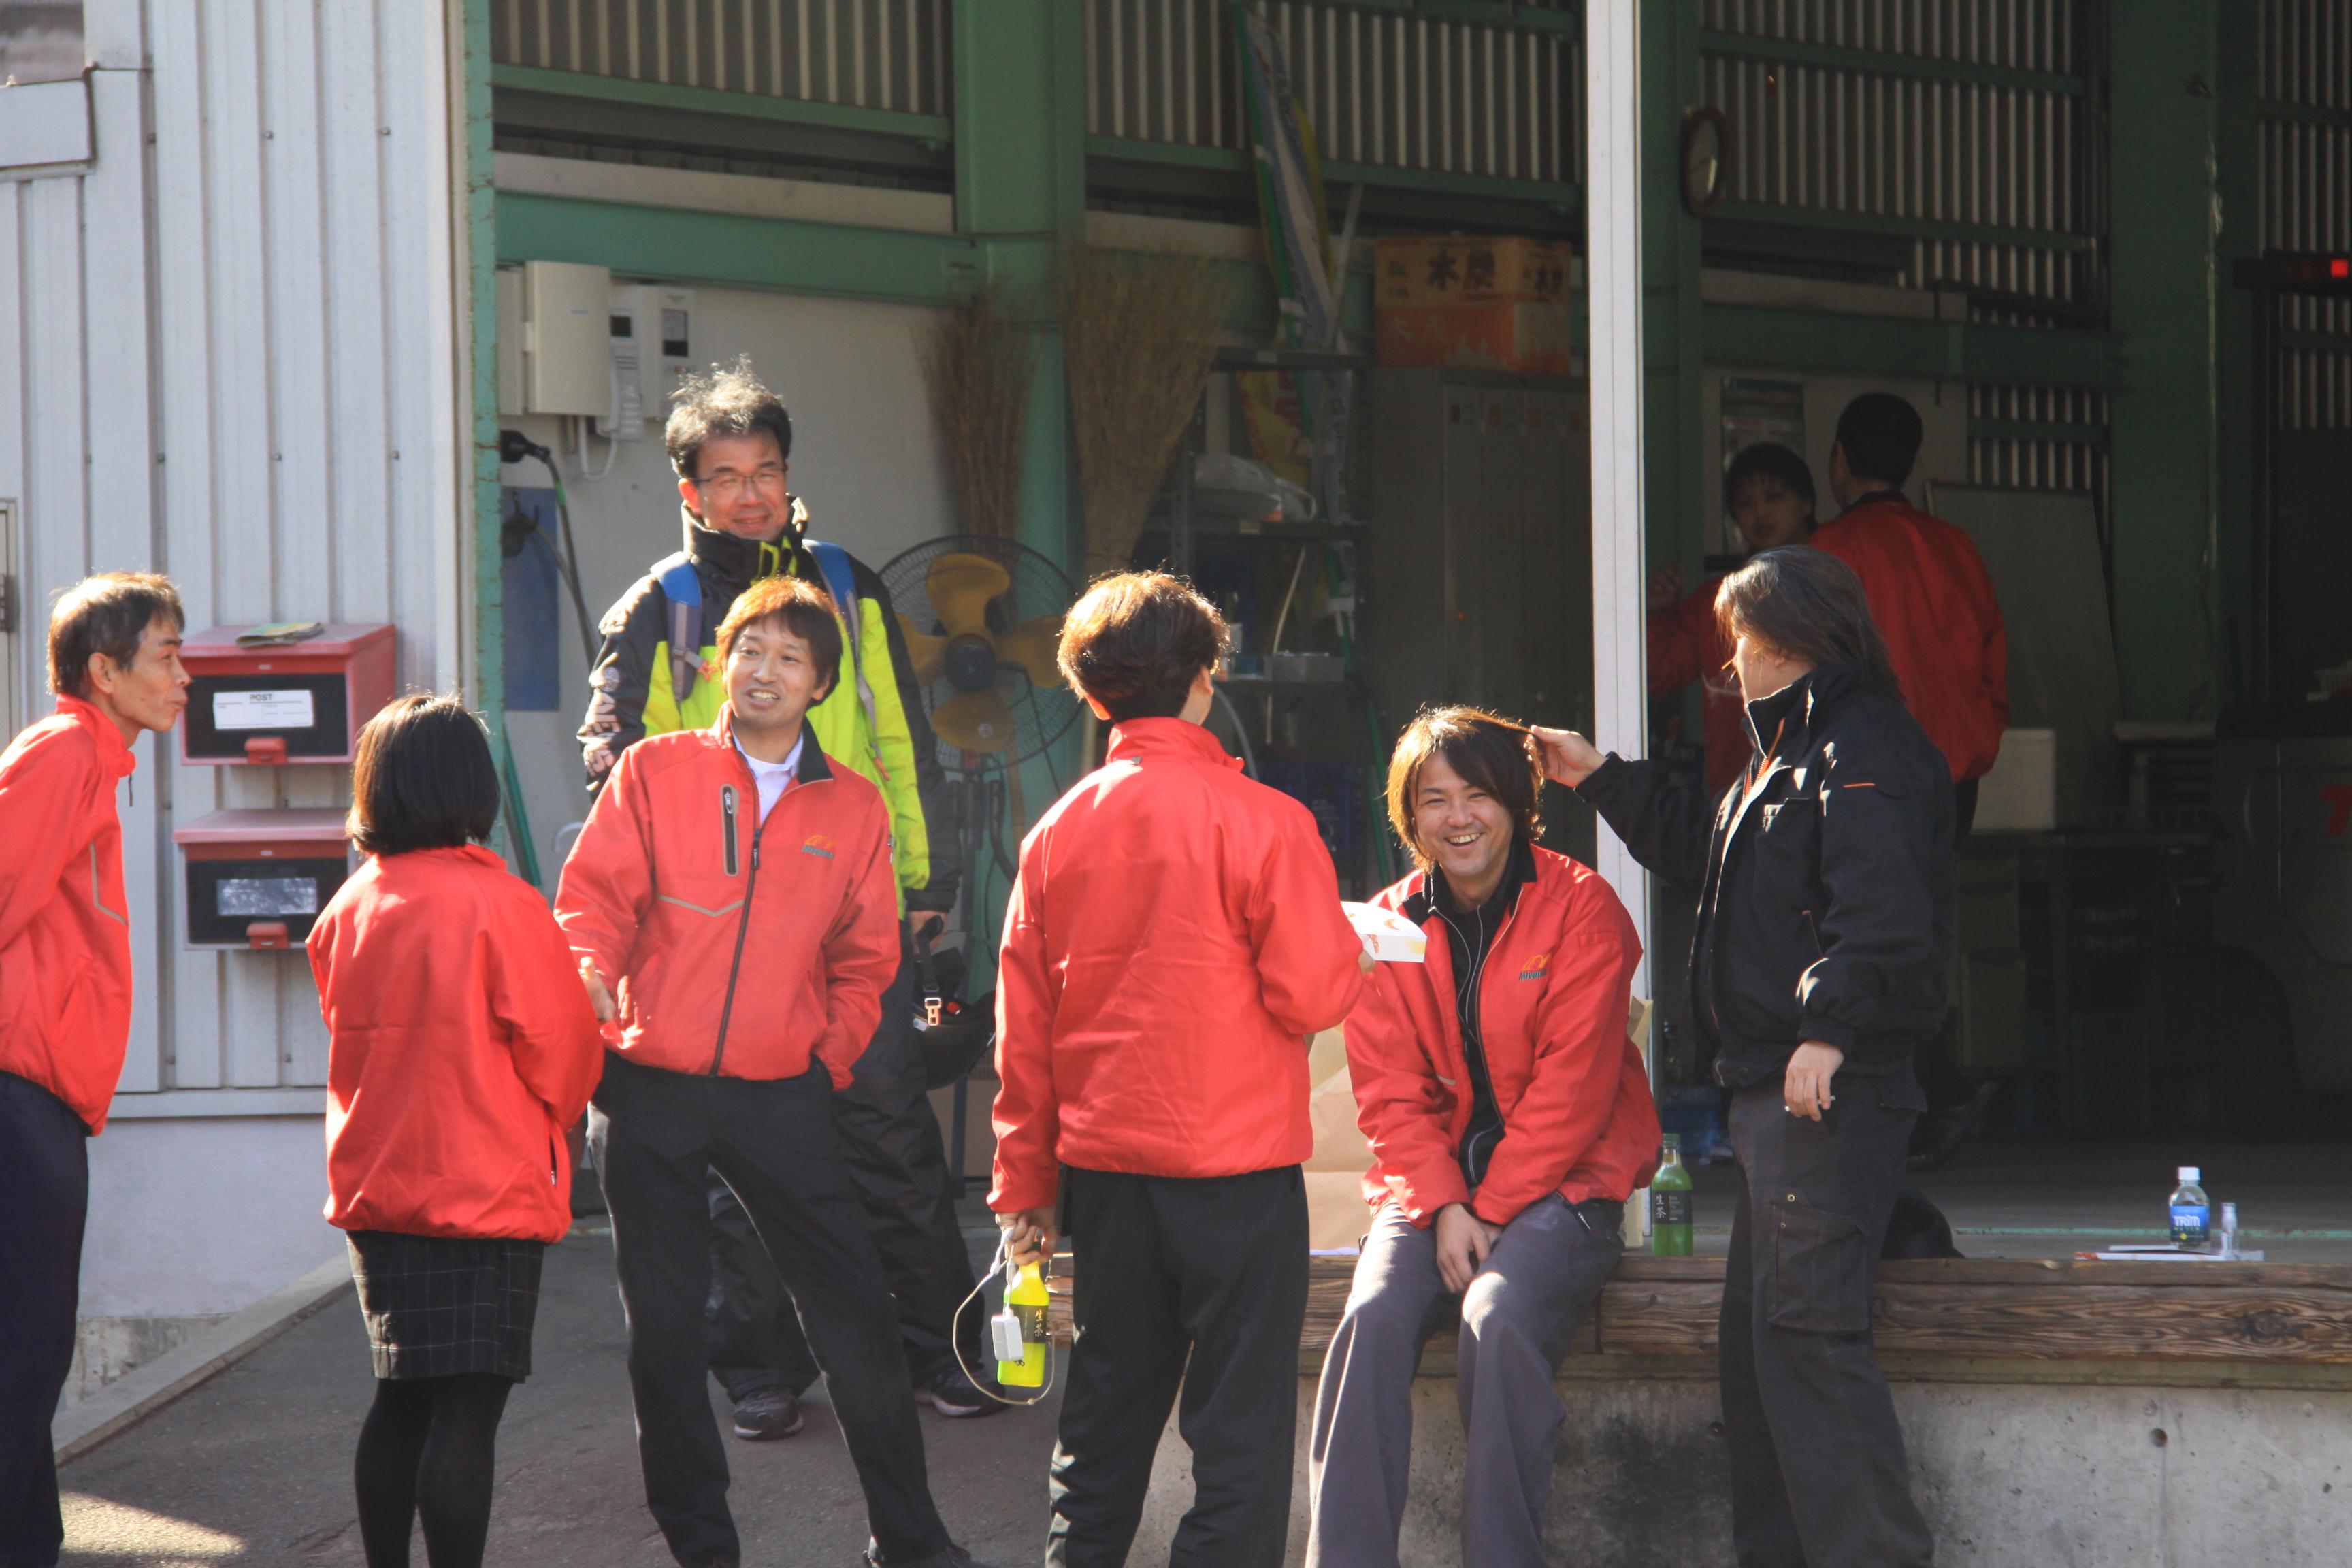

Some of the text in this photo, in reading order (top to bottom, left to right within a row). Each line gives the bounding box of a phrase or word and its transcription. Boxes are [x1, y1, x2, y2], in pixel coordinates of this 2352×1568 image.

[250, 693, 273, 702] POST
[1656, 1194, 1667, 1218] 生茶
[1034, 1309, 1043, 1337] 生茶
